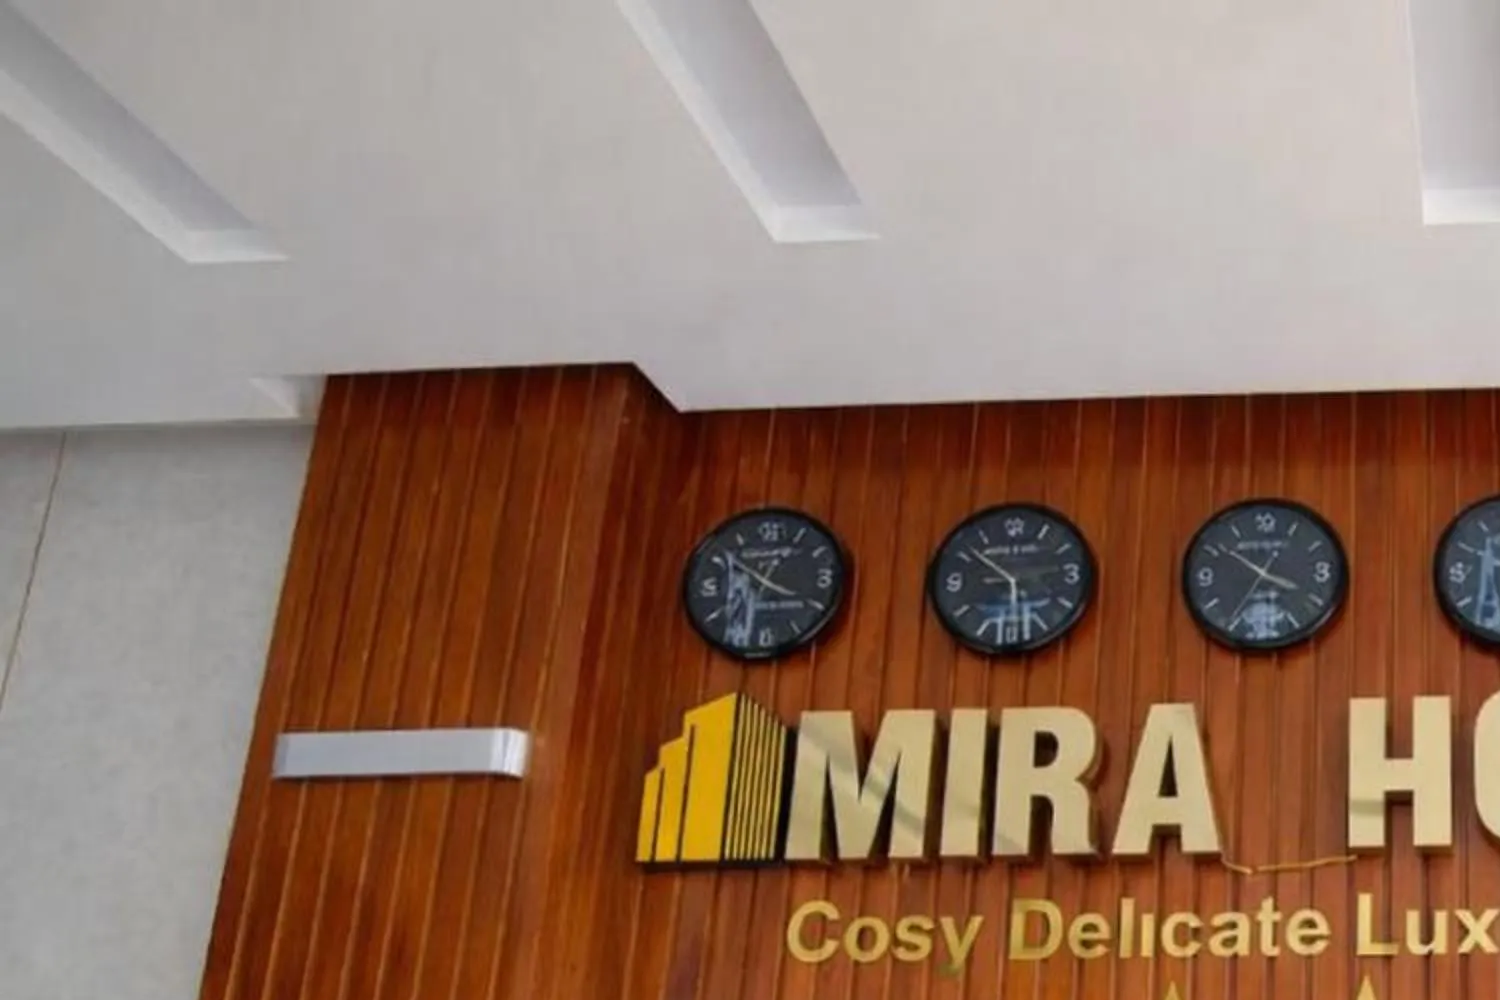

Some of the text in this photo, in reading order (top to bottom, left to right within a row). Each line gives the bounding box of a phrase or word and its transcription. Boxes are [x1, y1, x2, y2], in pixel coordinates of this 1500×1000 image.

[1062, 563, 1081, 584] 3
[784, 703, 1224, 863] MIRA
[786, 899, 985, 975] Cosy
